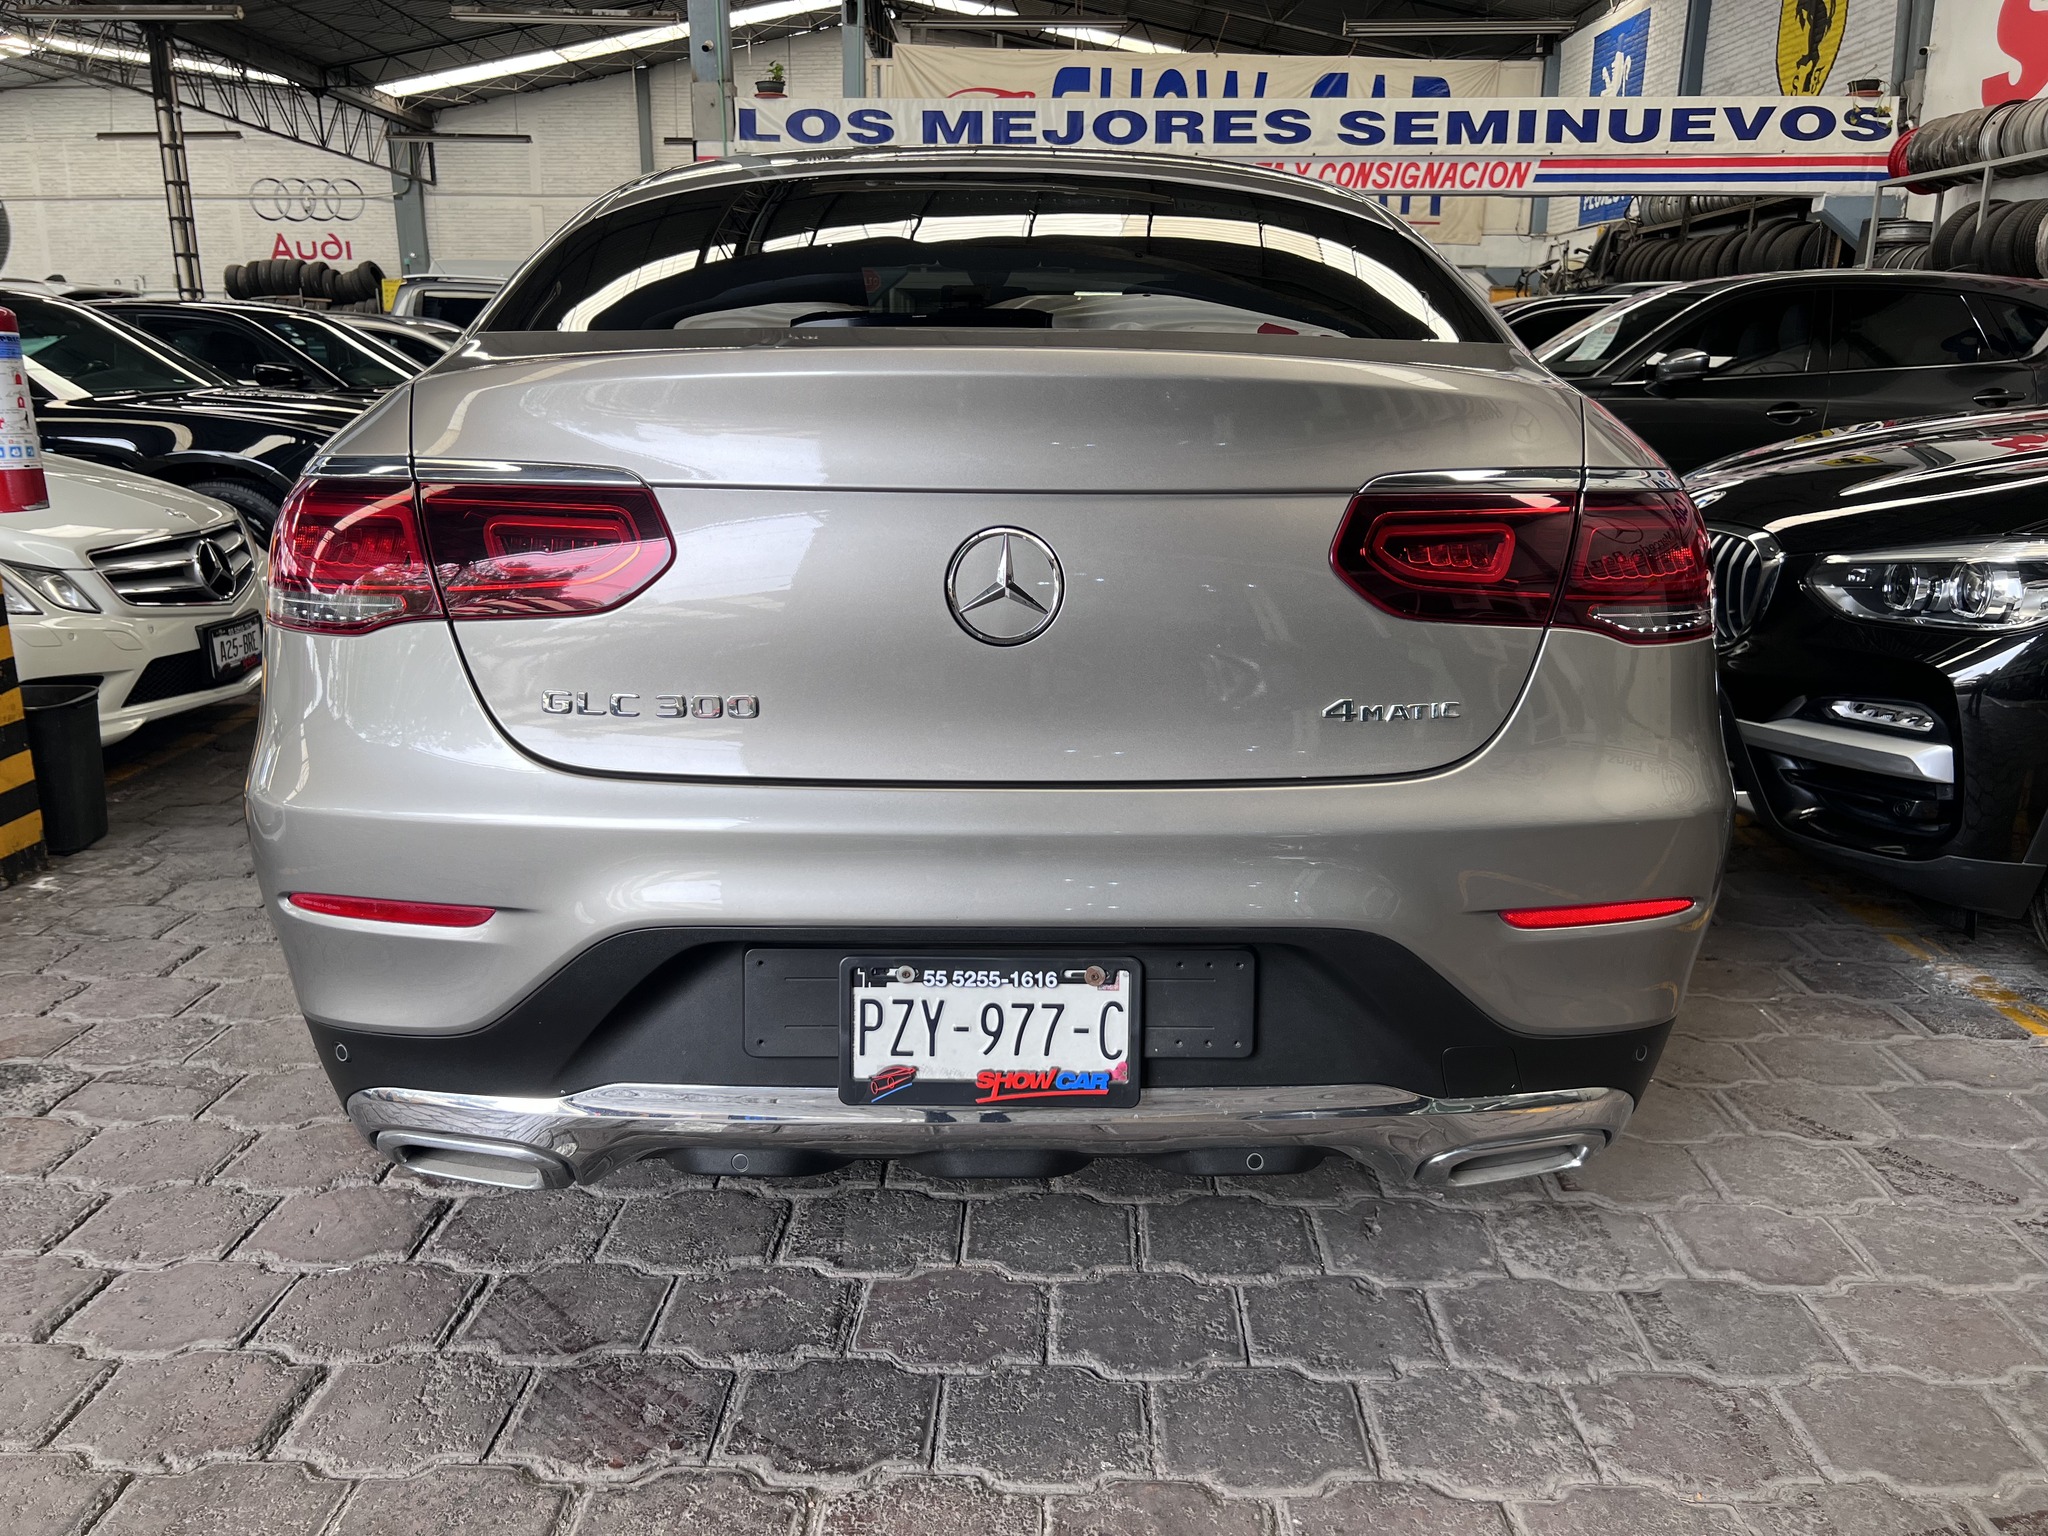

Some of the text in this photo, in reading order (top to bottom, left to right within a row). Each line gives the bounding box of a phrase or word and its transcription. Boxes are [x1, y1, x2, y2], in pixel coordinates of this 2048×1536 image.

[738, 105, 1892, 145] LOS MEJORES SEMINUEVOS
[1318, 162, 1531, 189] CONSIGNACION
[271, 233, 352, 260] Audi
[220, 630, 259, 662] A25-BRE
[541, 690, 760, 718] GLC 300
[1321, 698, 1461, 722] 4MATIC
[923, 970, 1058, 988] 55 5255-1616
[859, 999, 1124, 1060] PZY-977-C
